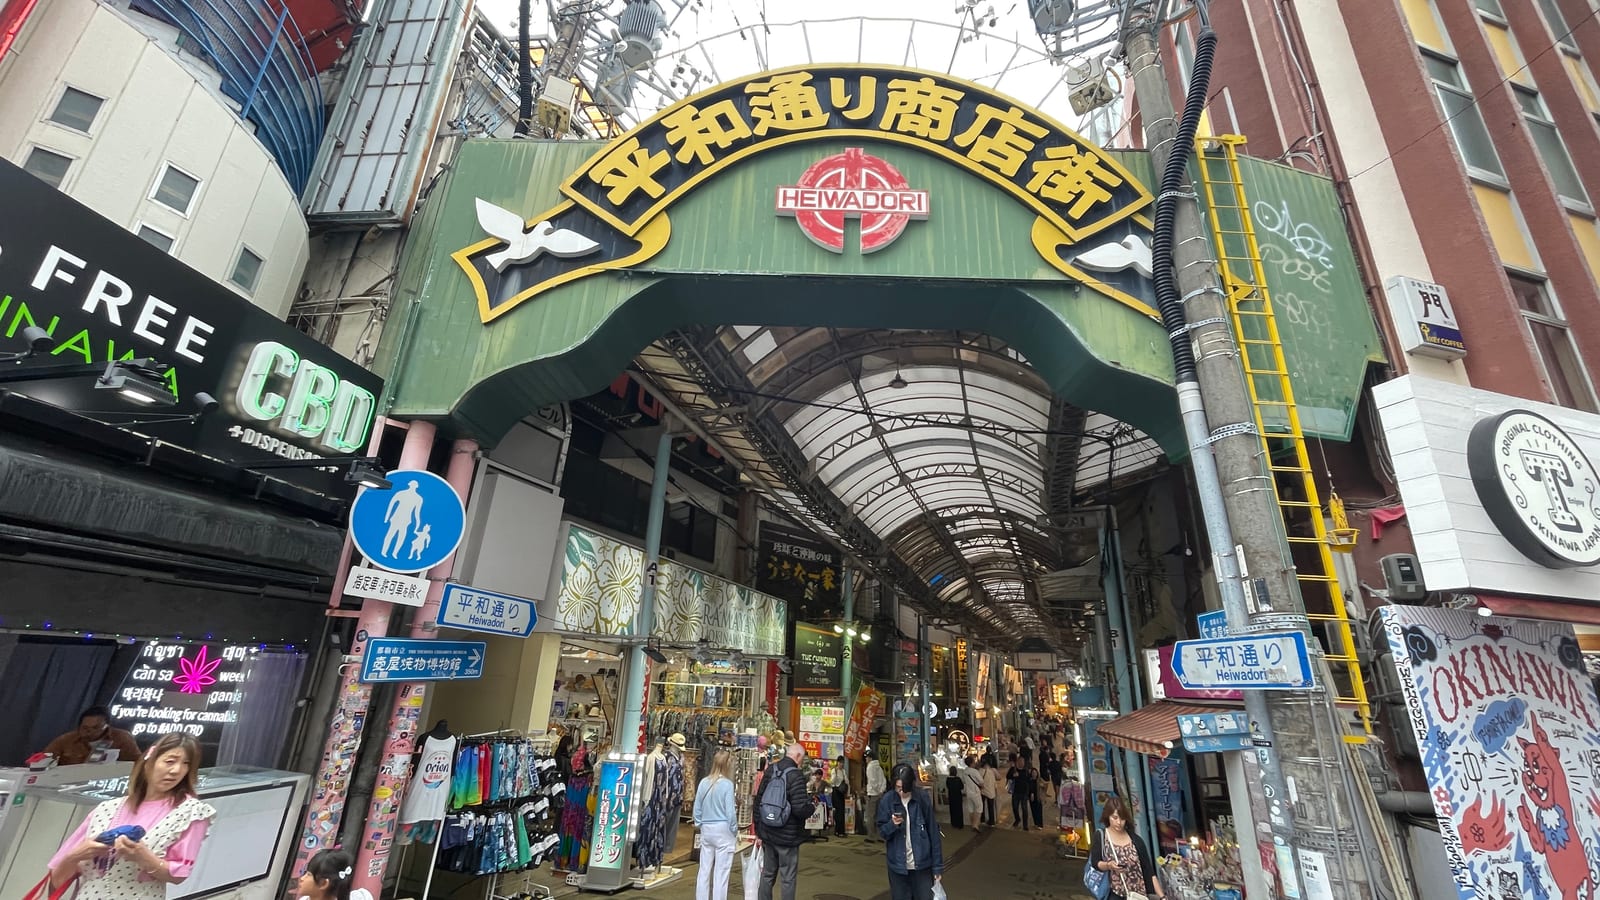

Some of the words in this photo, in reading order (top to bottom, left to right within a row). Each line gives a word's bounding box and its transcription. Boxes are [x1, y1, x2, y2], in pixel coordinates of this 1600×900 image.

[589, 71, 1124, 220] 平和通り商店街
[782, 187, 926, 212] HEIWADORI
[31, 245, 215, 363] FREE
[1418, 290, 1450, 320] 門
[1440, 338, 1465, 349] COFFEE
[236, 341, 375, 453] CBD
[1502, 421, 1531, 457] ORIGINAL
[1532, 424, 1582, 471] CLOTHING
[1530, 515, 1580, 553] OKINAWA
[457, 592, 519, 619] 平和通り
[468, 614, 505, 629] Heiwadori
[1195, 642, 1283, 669] 平和通り
[158, 669, 174, 681] sa
[1216, 667, 1268, 682] Heiwadori
[1430, 644, 1598, 732] OKINAWA
[149, 706, 181, 722] looking
[182, 707, 197, 721] for
[1399, 667, 1429, 741] WELCOME
[132, 723, 145, 736] go
[147, 722, 157, 733] to
[425, 761, 449, 773] Orion
[1159, 765, 1173, 819] アイスコーヒー
[608, 766, 630, 864] アロハシャツ
